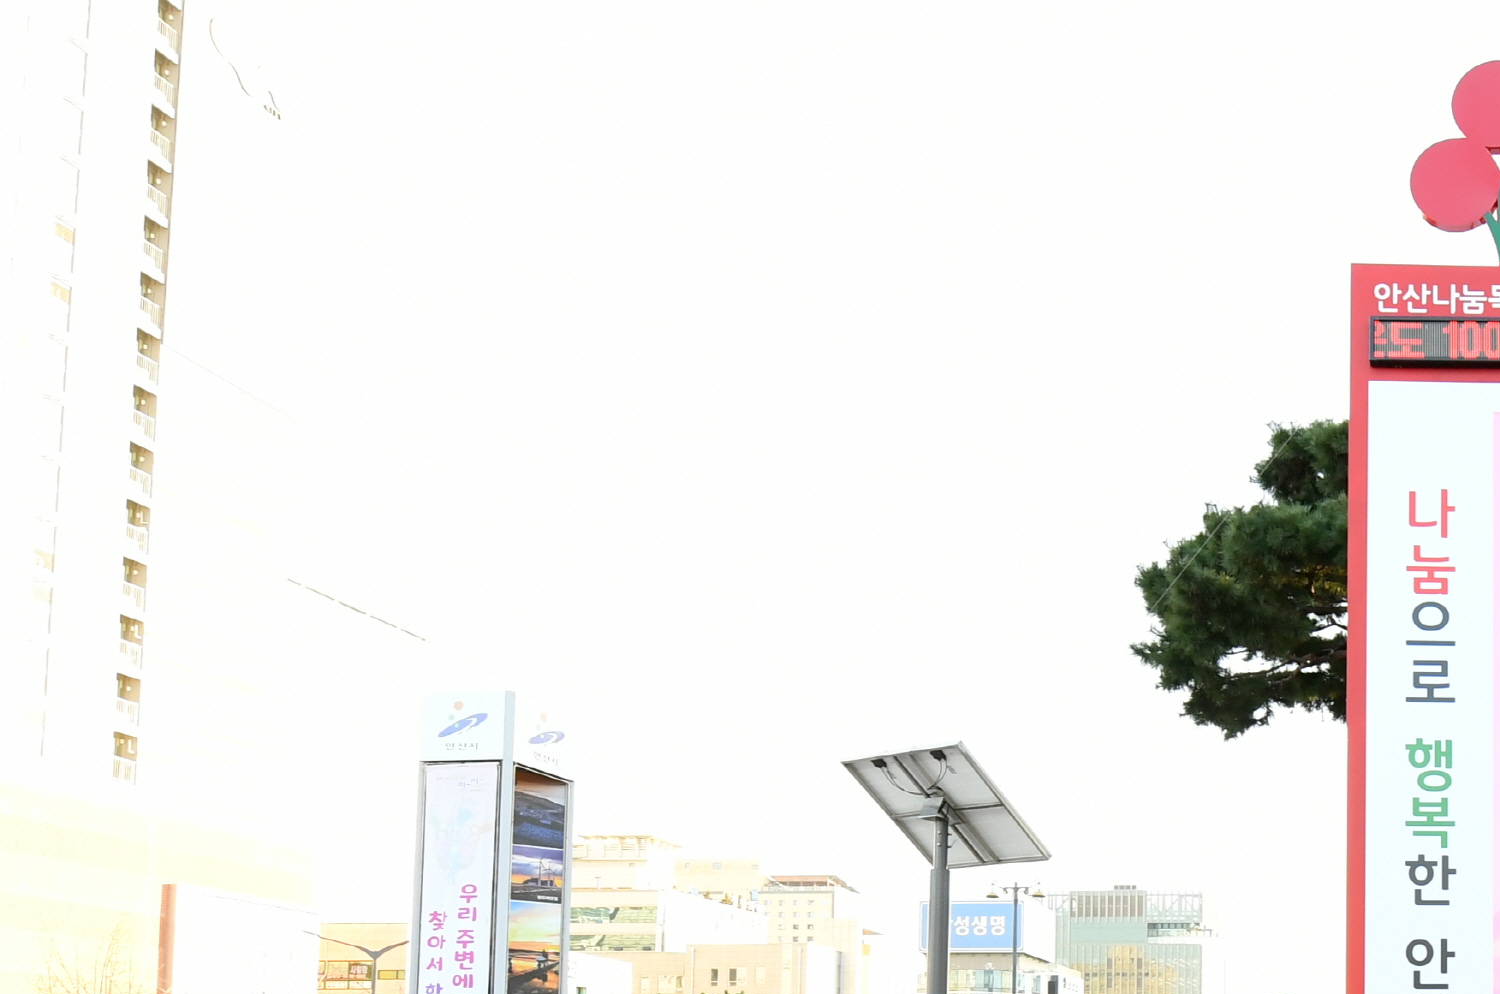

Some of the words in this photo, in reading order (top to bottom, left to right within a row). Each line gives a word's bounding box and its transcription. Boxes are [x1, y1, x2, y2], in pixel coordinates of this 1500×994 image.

[1405, 488, 1456, 704] 나눔으로
[1404, 737, 1457, 907] 행복한
[457, 883, 478, 922] 우리
[951, 914, 1006, 937] 성생명
[426, 910, 447, 972] 찾아서
[452, 929, 475, 989] 주변에
